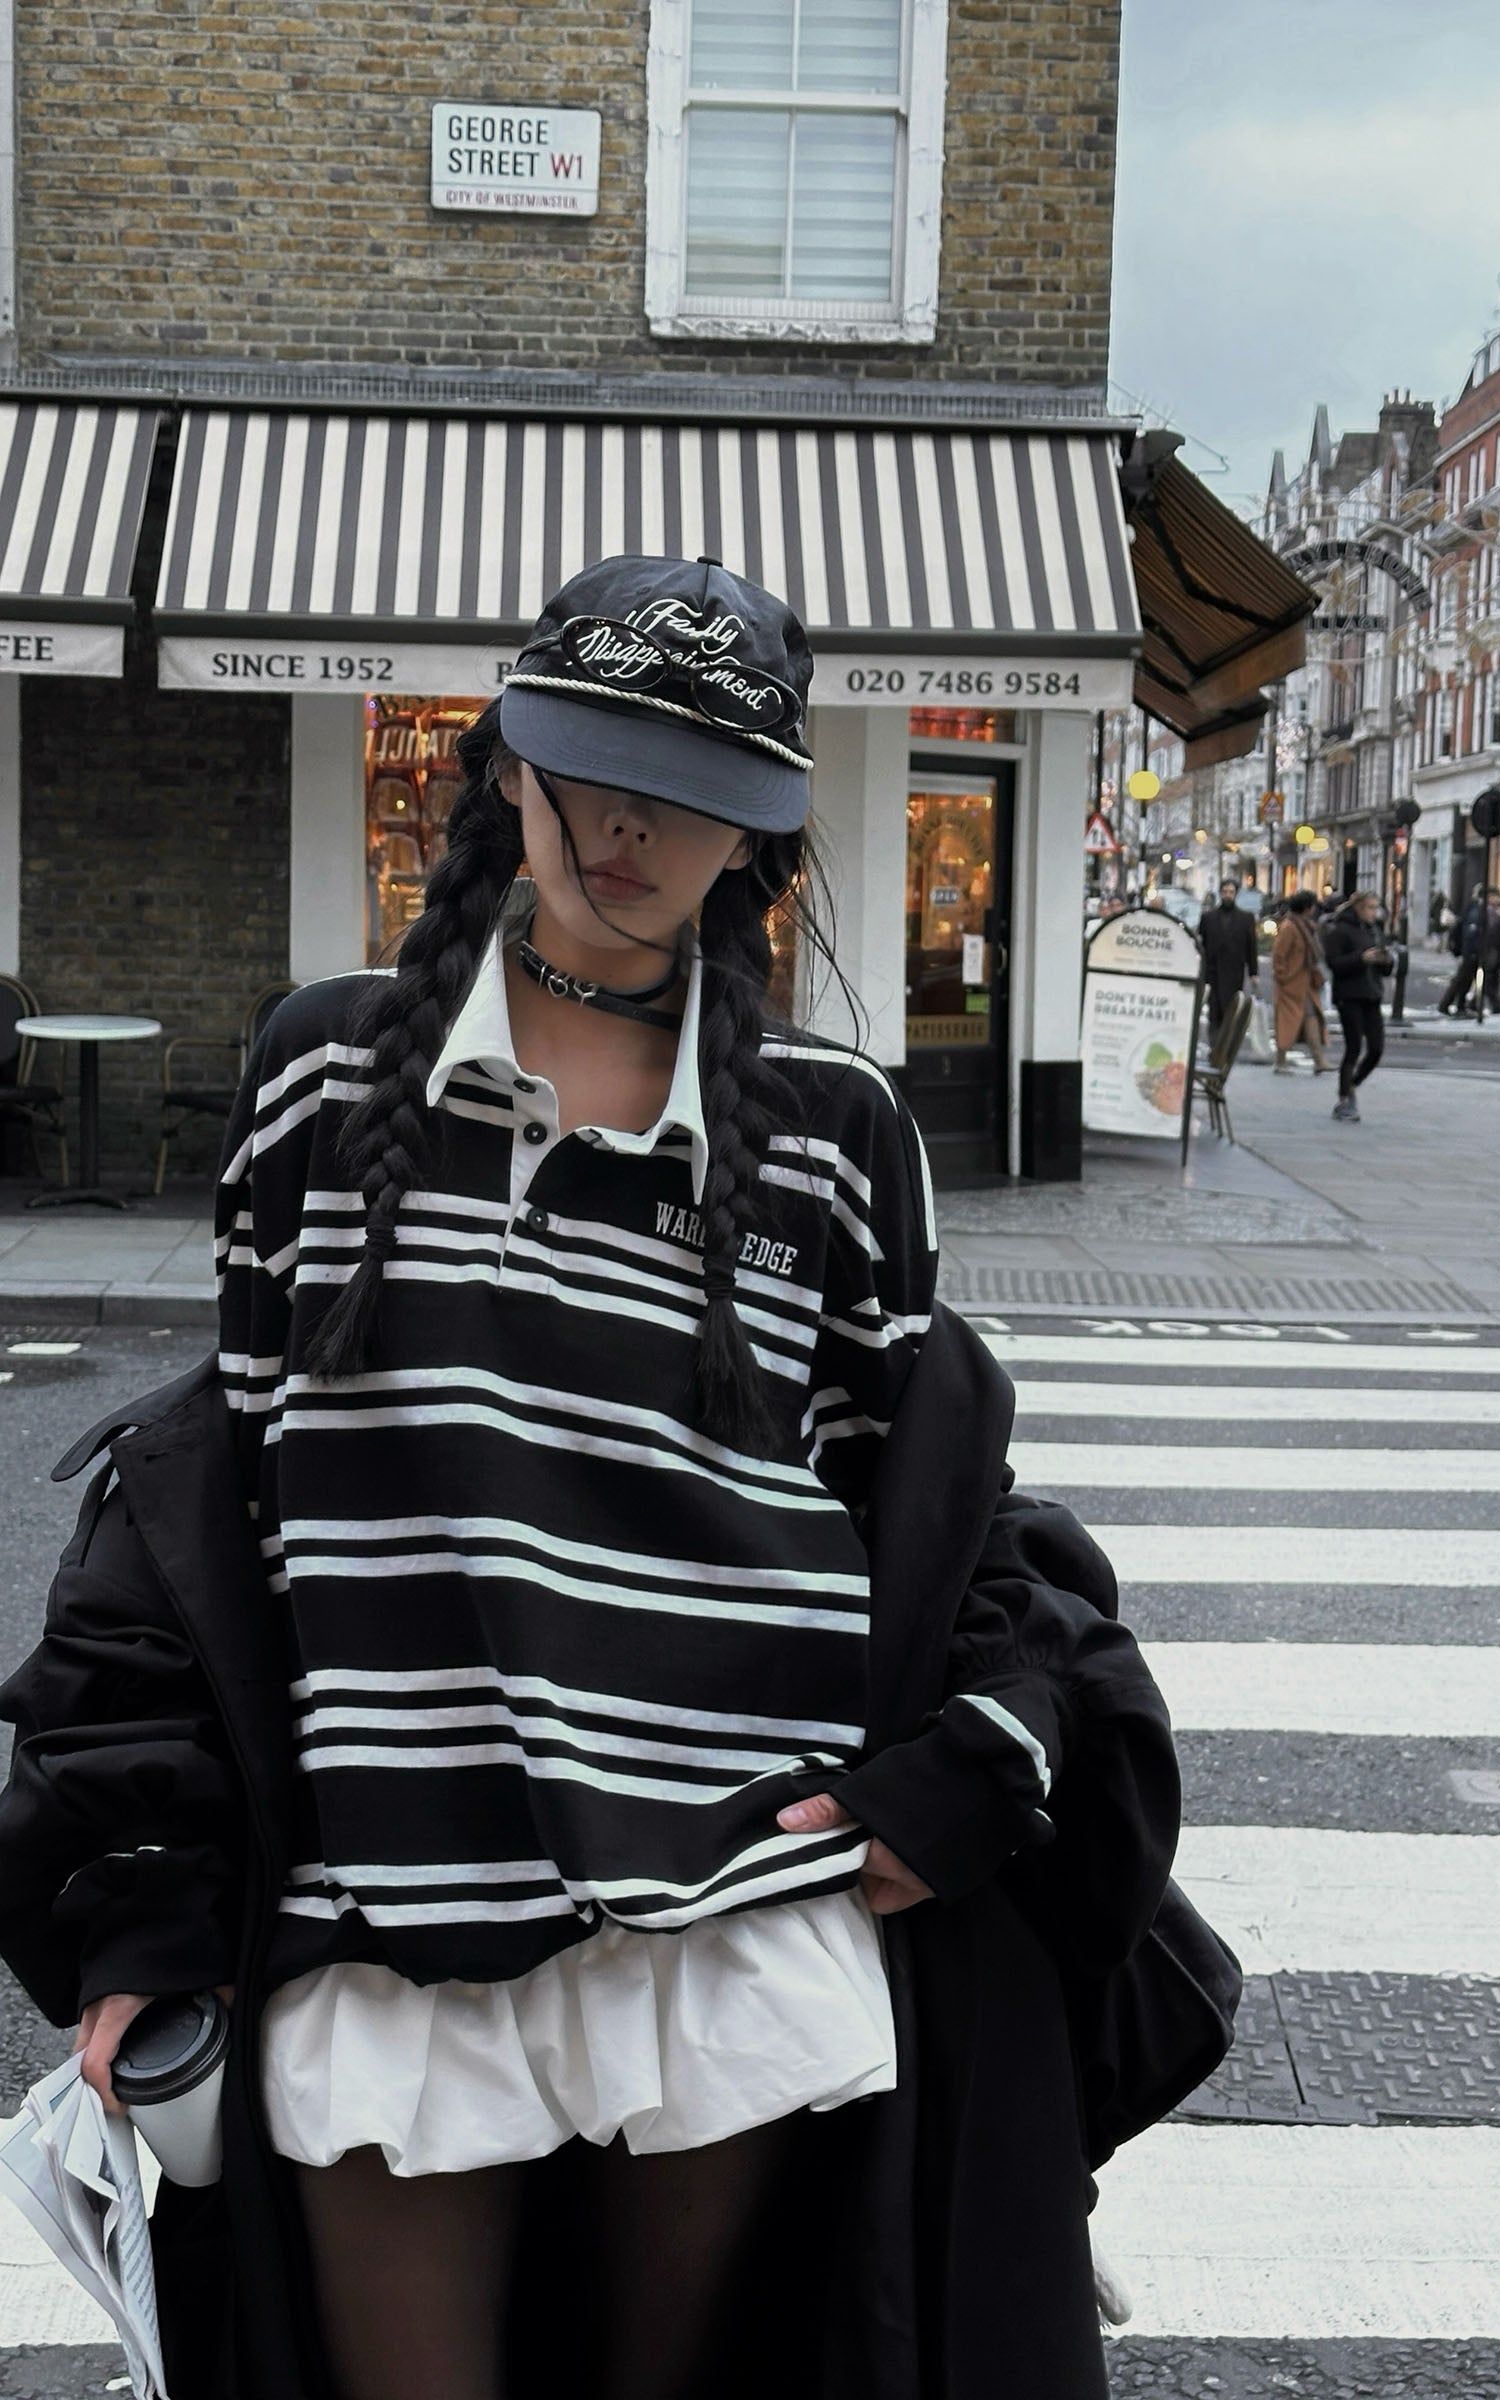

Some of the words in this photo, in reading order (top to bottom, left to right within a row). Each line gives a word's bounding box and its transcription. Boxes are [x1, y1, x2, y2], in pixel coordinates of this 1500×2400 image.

[449, 115, 549, 145] GEORGE
[448, 148, 540, 177] STREET
[551, 153, 582, 179] W1
[446, 190, 471, 205] CITY
[624, 598, 746, 655] Family
[212, 653, 305, 679] SINCE
[319, 656, 393, 681] 1952
[846, 668, 905, 693] 020
[917, 670, 993, 695] 7486
[1004, 671, 1081, 696] 9584
[1121, 924, 1170, 937] BONNE
[1116, 936, 1174, 950] BOUCHE
[1095, 990, 1136, 1004] DON'T
[1140, 995, 1169, 1007] SKIP
[1094, 1003, 1177, 1022] BREAKFAST!
[1076, 1319, 1351, 1341] LOOK
